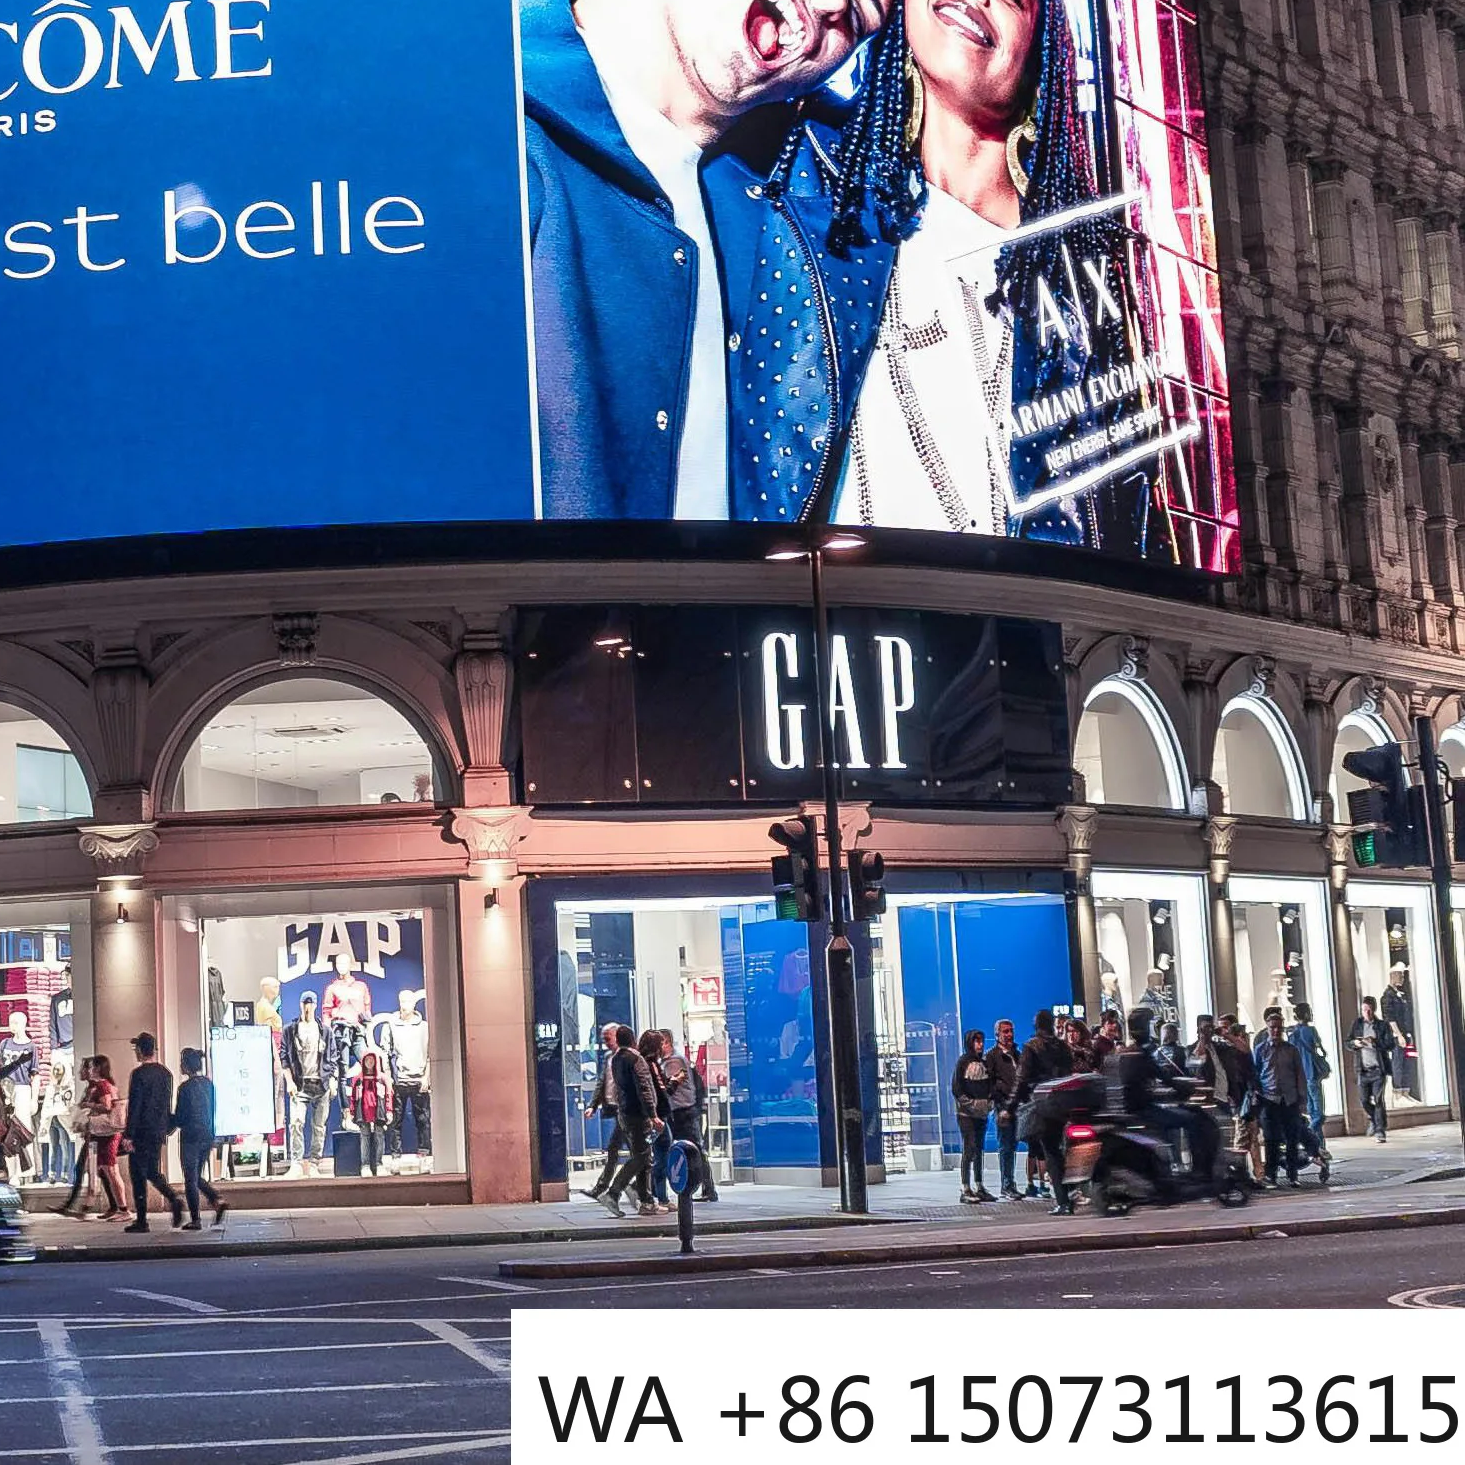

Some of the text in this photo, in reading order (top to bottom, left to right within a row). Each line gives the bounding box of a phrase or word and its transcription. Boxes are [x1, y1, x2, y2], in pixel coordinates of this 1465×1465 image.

[164, 180, 425, 264] belle
[1010, 384, 1086, 439] ARMANI
[1045, 444, 1073, 471] NEW
[1109, 416, 1136, 443] SAME
[762, 631, 916, 771] GAP
[278, 917, 402, 984] GAP
[538, 1024, 558, 1038] GAP
